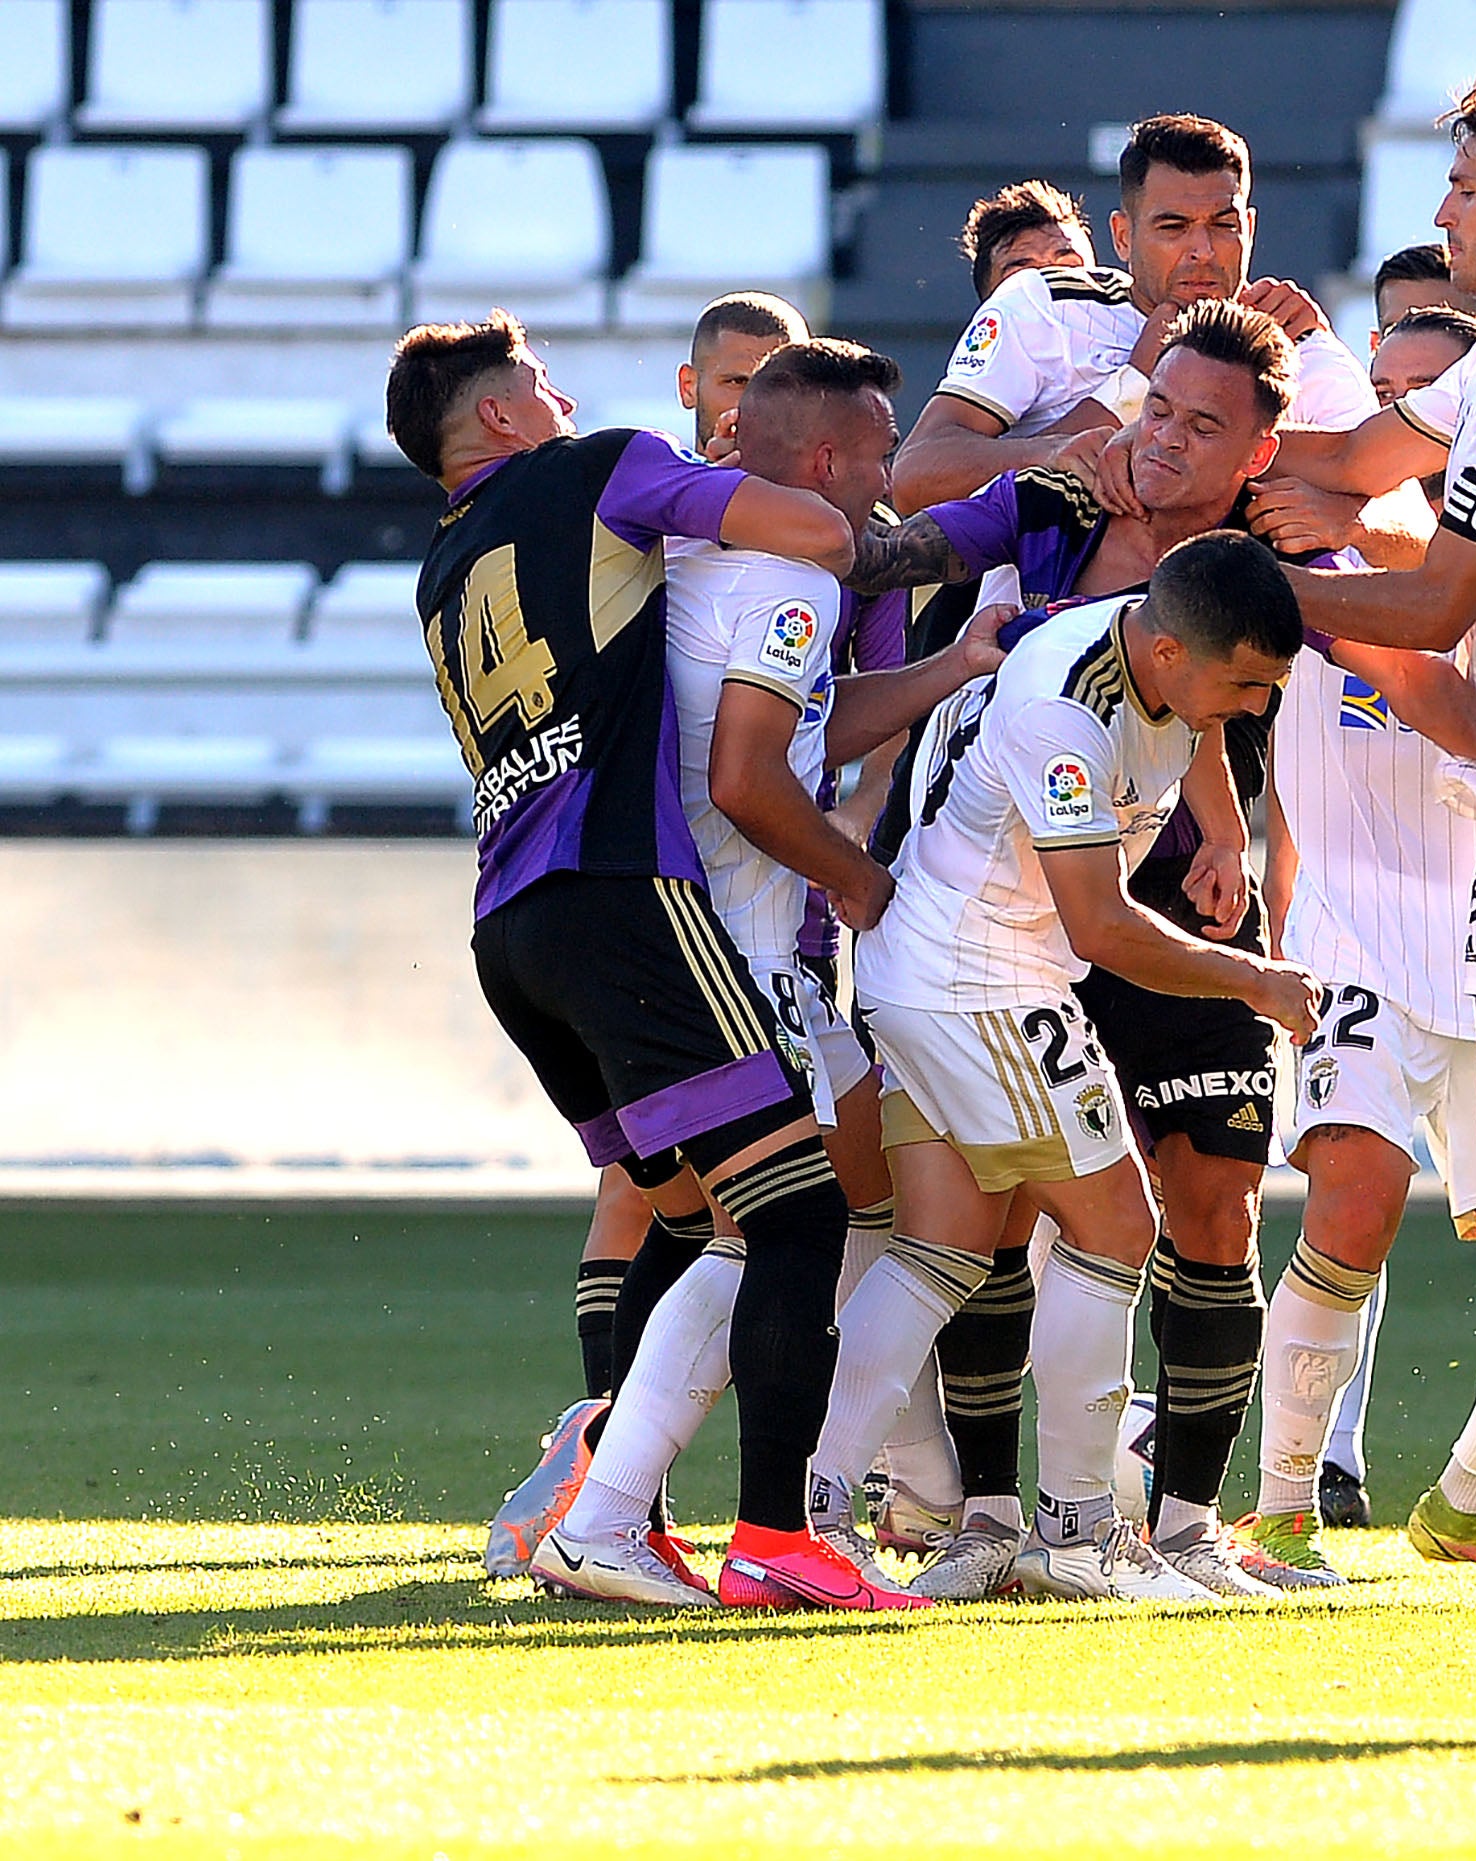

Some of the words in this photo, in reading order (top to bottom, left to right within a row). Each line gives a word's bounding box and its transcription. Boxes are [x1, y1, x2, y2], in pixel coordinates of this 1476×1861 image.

[427, 543, 557, 782] 14
[766, 645, 802, 667] LaLiga
[472, 714, 583, 817] RBALIFE
[1049, 802, 1089, 817] LaLiga
[1227, 1117, 1264, 1133] adidas
